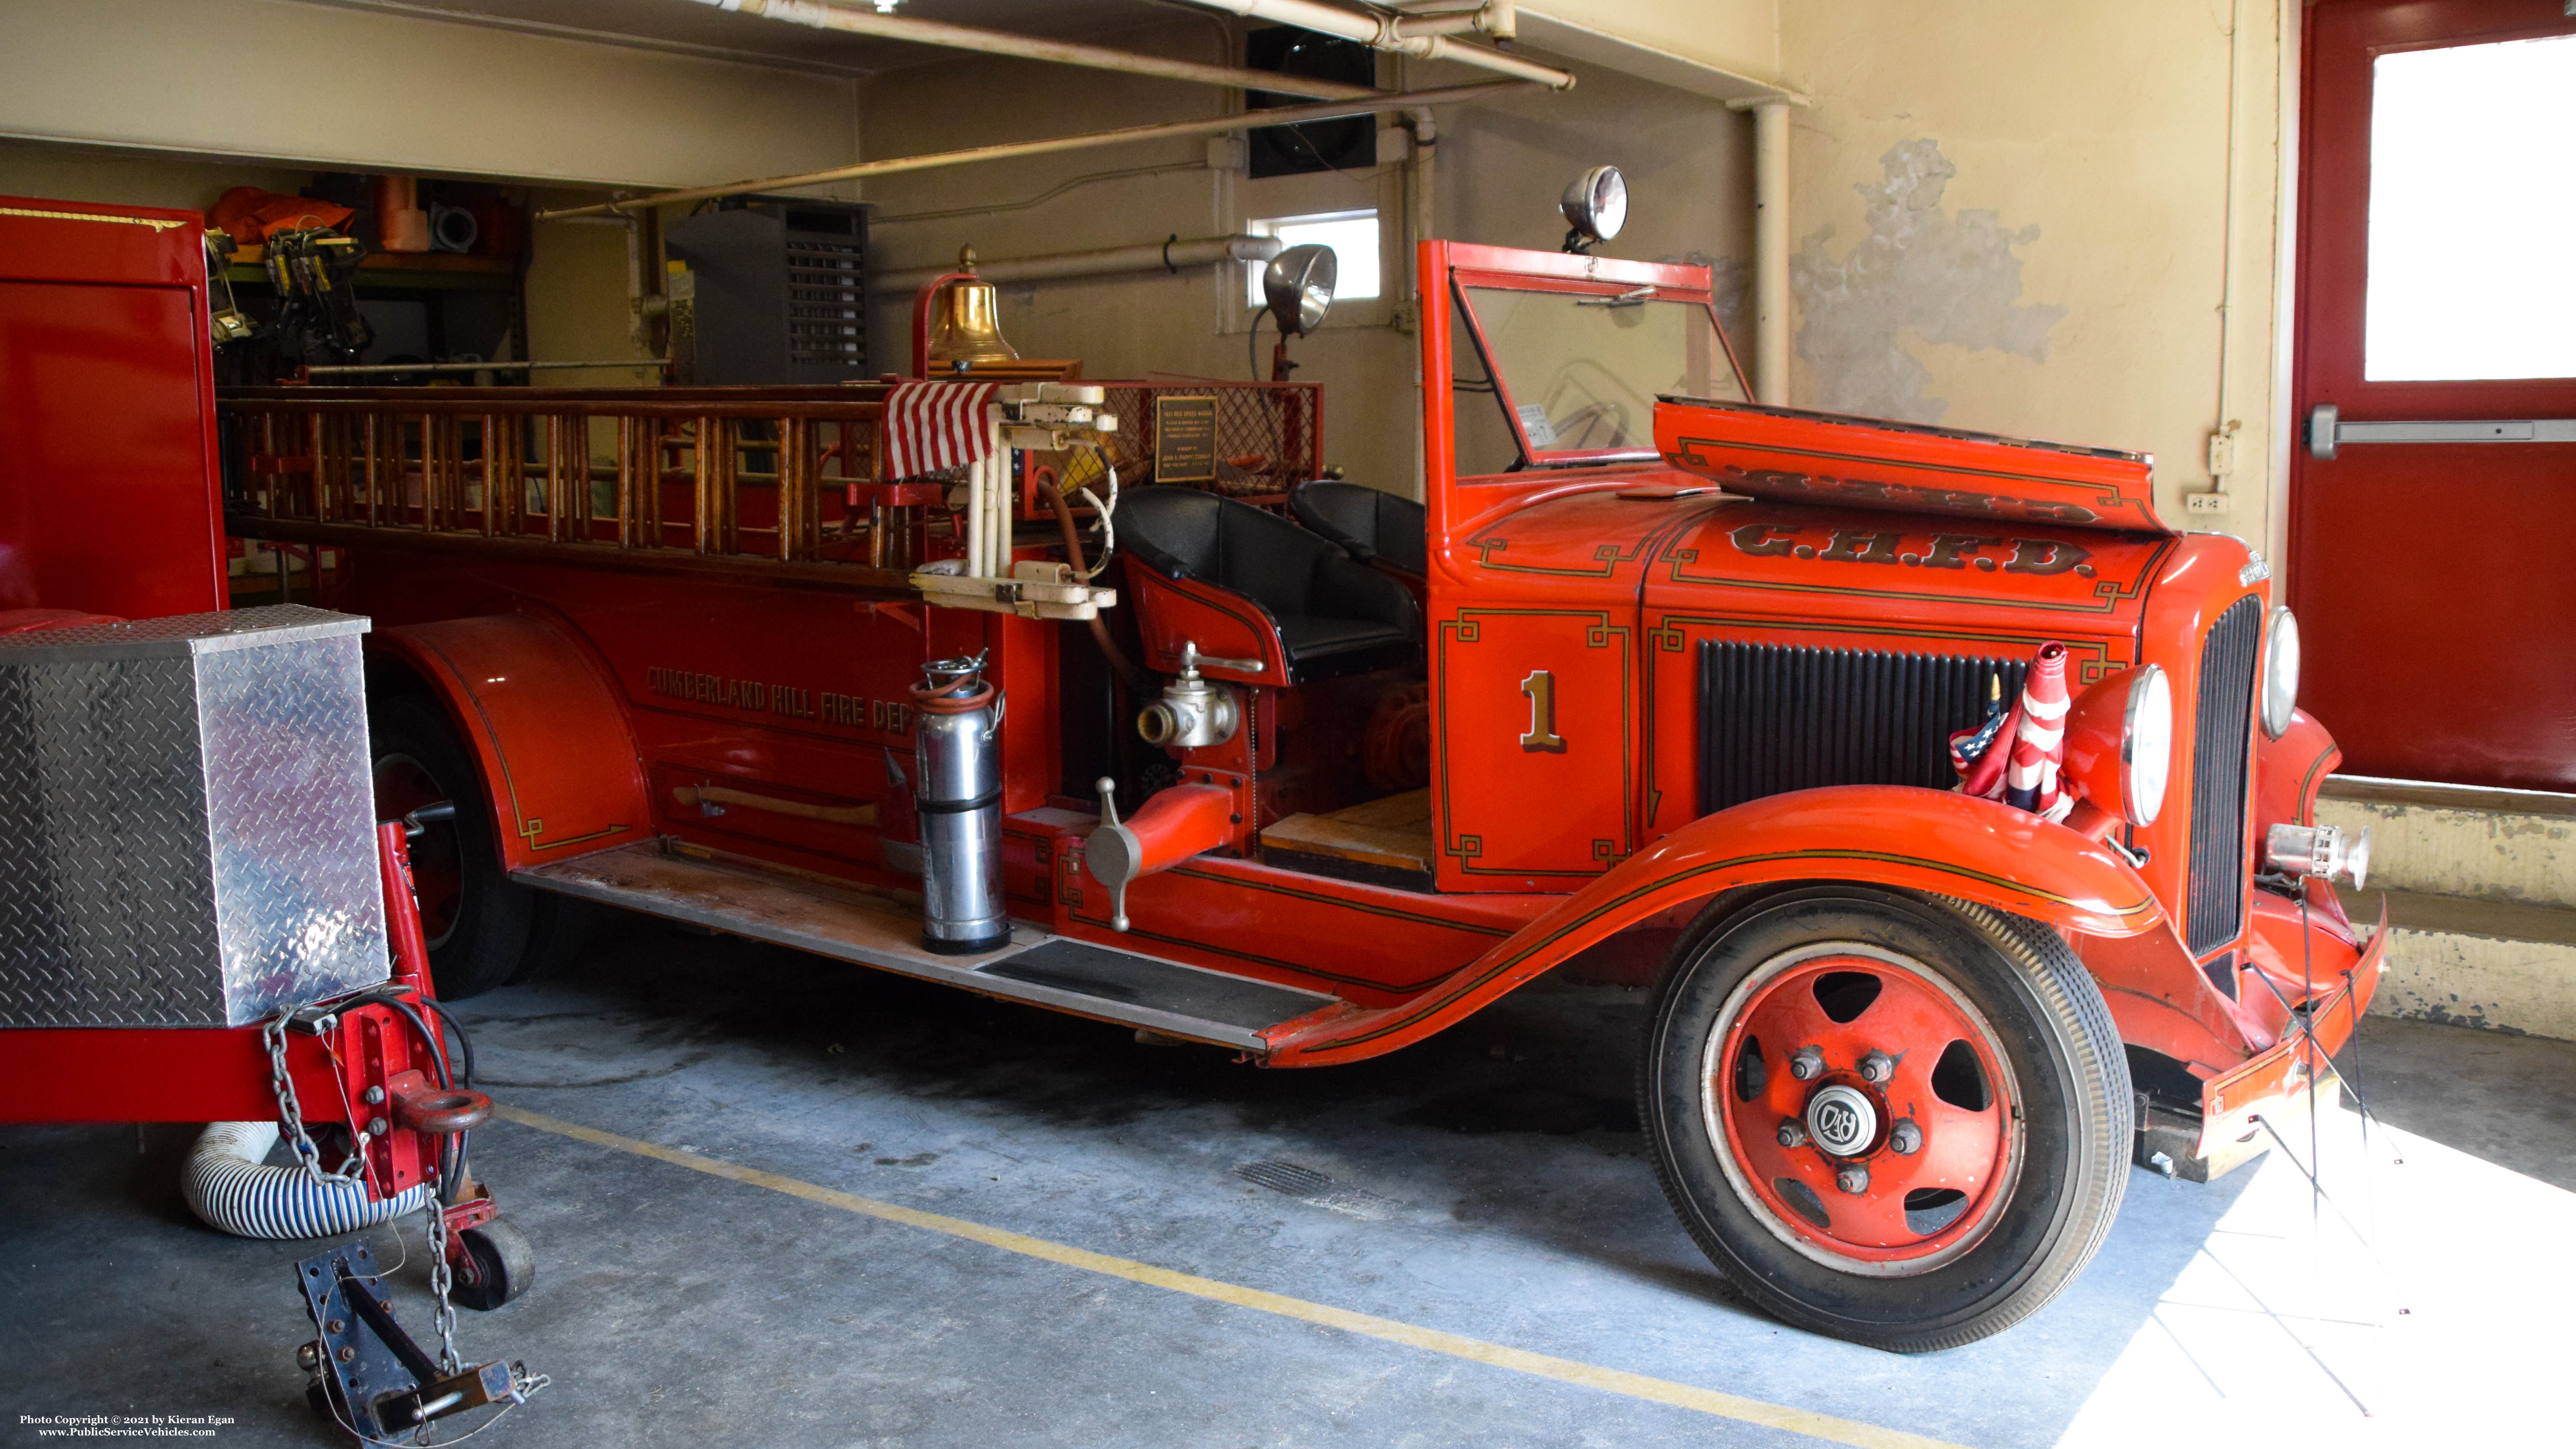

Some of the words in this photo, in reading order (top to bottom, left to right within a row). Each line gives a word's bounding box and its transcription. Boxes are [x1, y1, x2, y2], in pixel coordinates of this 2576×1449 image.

[646, 666, 766, 711] CUMBERLAND
[772, 684, 815, 718] HILL
[821, 692, 865, 726] FIRE
[873, 699, 915, 735] DEP
[1520, 670, 1567, 754] 1
